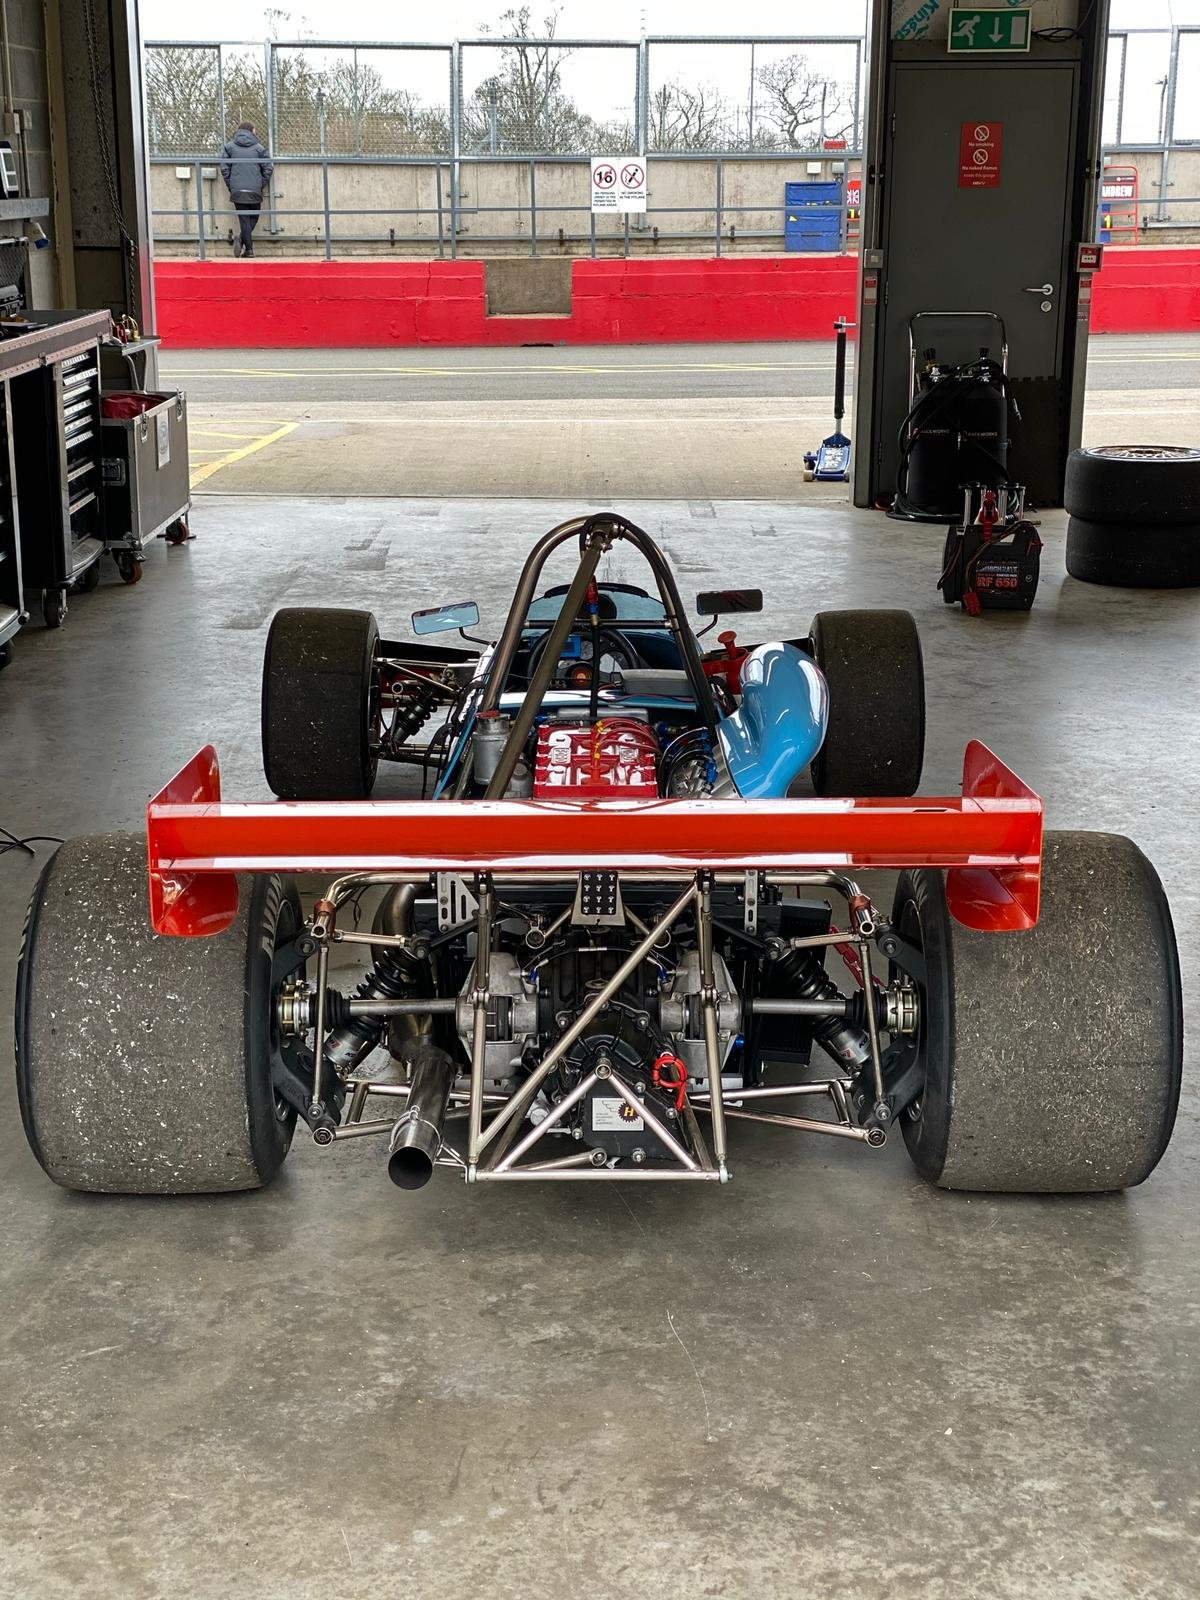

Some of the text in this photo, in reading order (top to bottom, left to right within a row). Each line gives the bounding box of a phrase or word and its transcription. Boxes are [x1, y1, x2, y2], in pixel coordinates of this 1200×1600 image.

[597, 171, 613, 184] 16
[976, 576, 1018, 588] RF 650
[623, 1106, 635, 1117] H
